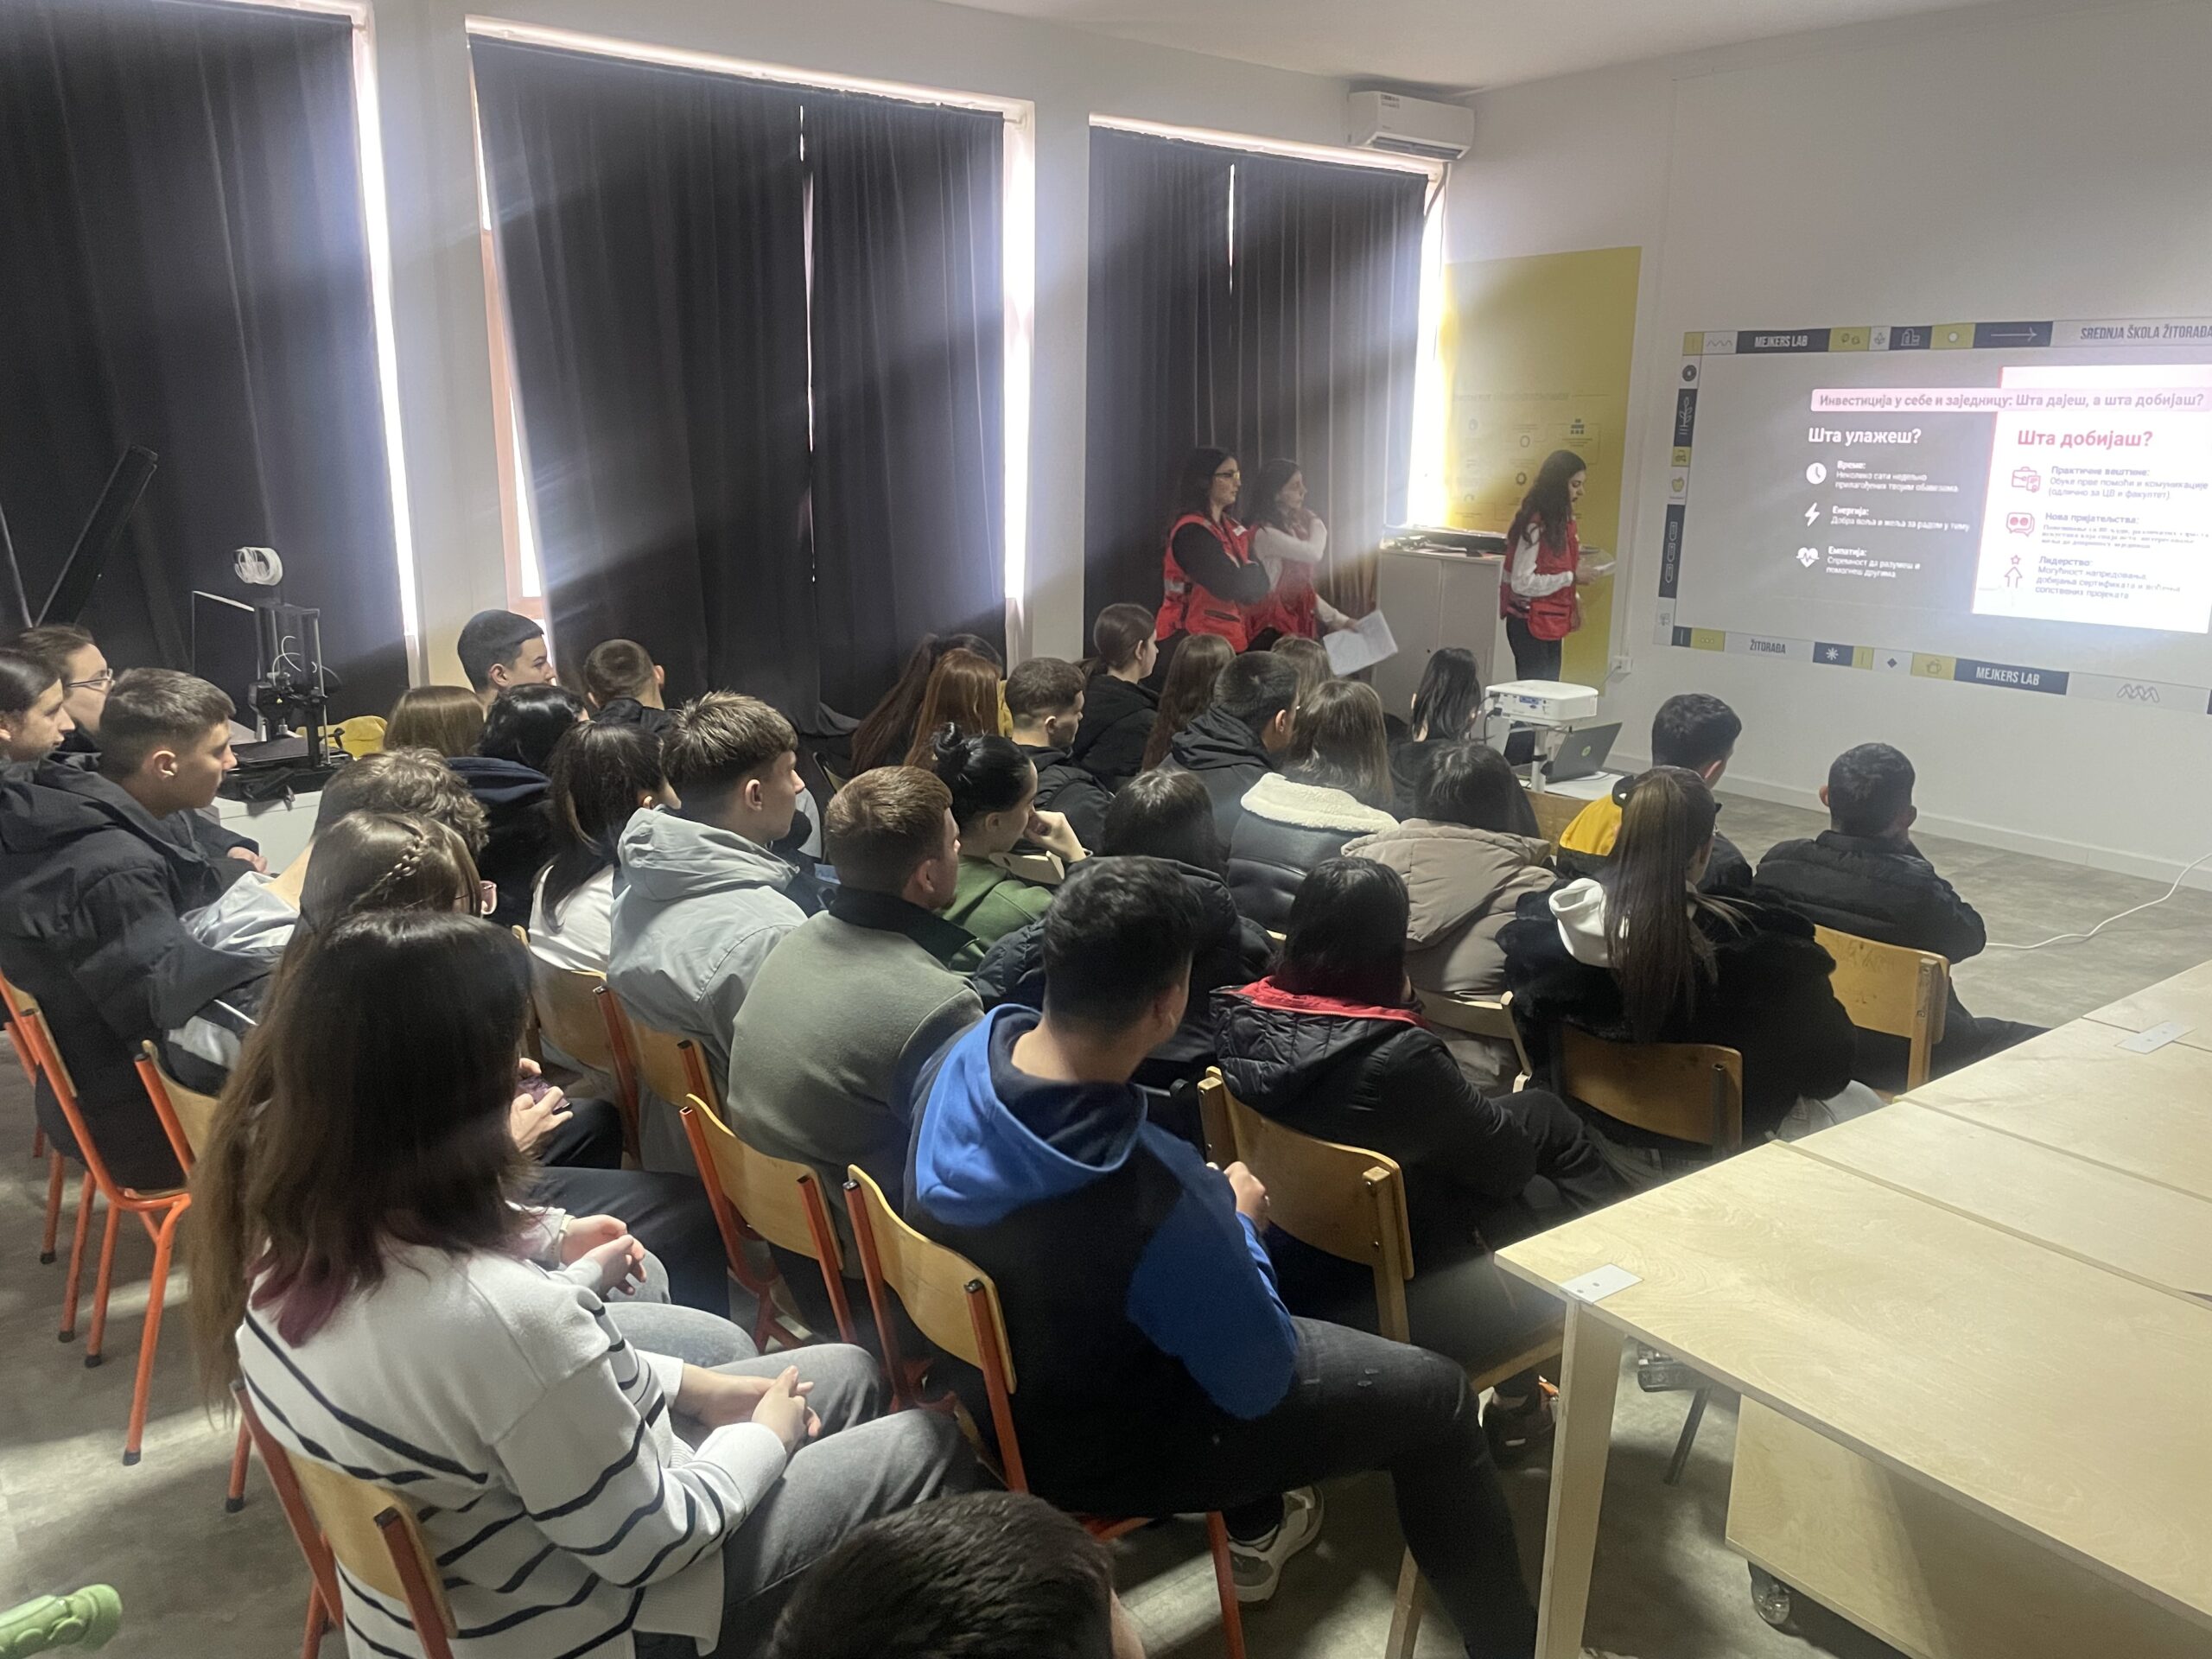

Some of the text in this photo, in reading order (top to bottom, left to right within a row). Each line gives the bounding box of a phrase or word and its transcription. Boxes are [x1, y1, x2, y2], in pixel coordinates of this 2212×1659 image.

[1754, 335, 1808, 347] MEJKERS LAB
[2081, 327, 2124, 340] SREDNJA
[2126, 325, 2160, 339] ŠKOLA
[1820, 395, 1892, 408] Инвестиција
[1894, 397, 1902, 408] у
[1904, 394, 1933, 406] себе
[1946, 394, 2012, 408] заједницу:
[2016, 394, 2044, 406] Шта
[2046, 394, 2089, 408] дајеш,
[2093, 397, 2101, 405] а
[2105, 397, 2133, 406] шта
[2135, 393, 2204, 408] добијаш?
[1808, 428, 1922, 447] Шта улажеш?
[2018, 430, 2153, 450] Шта добијаш?
[1975, 666, 2040, 685] MEJKERS LAB
